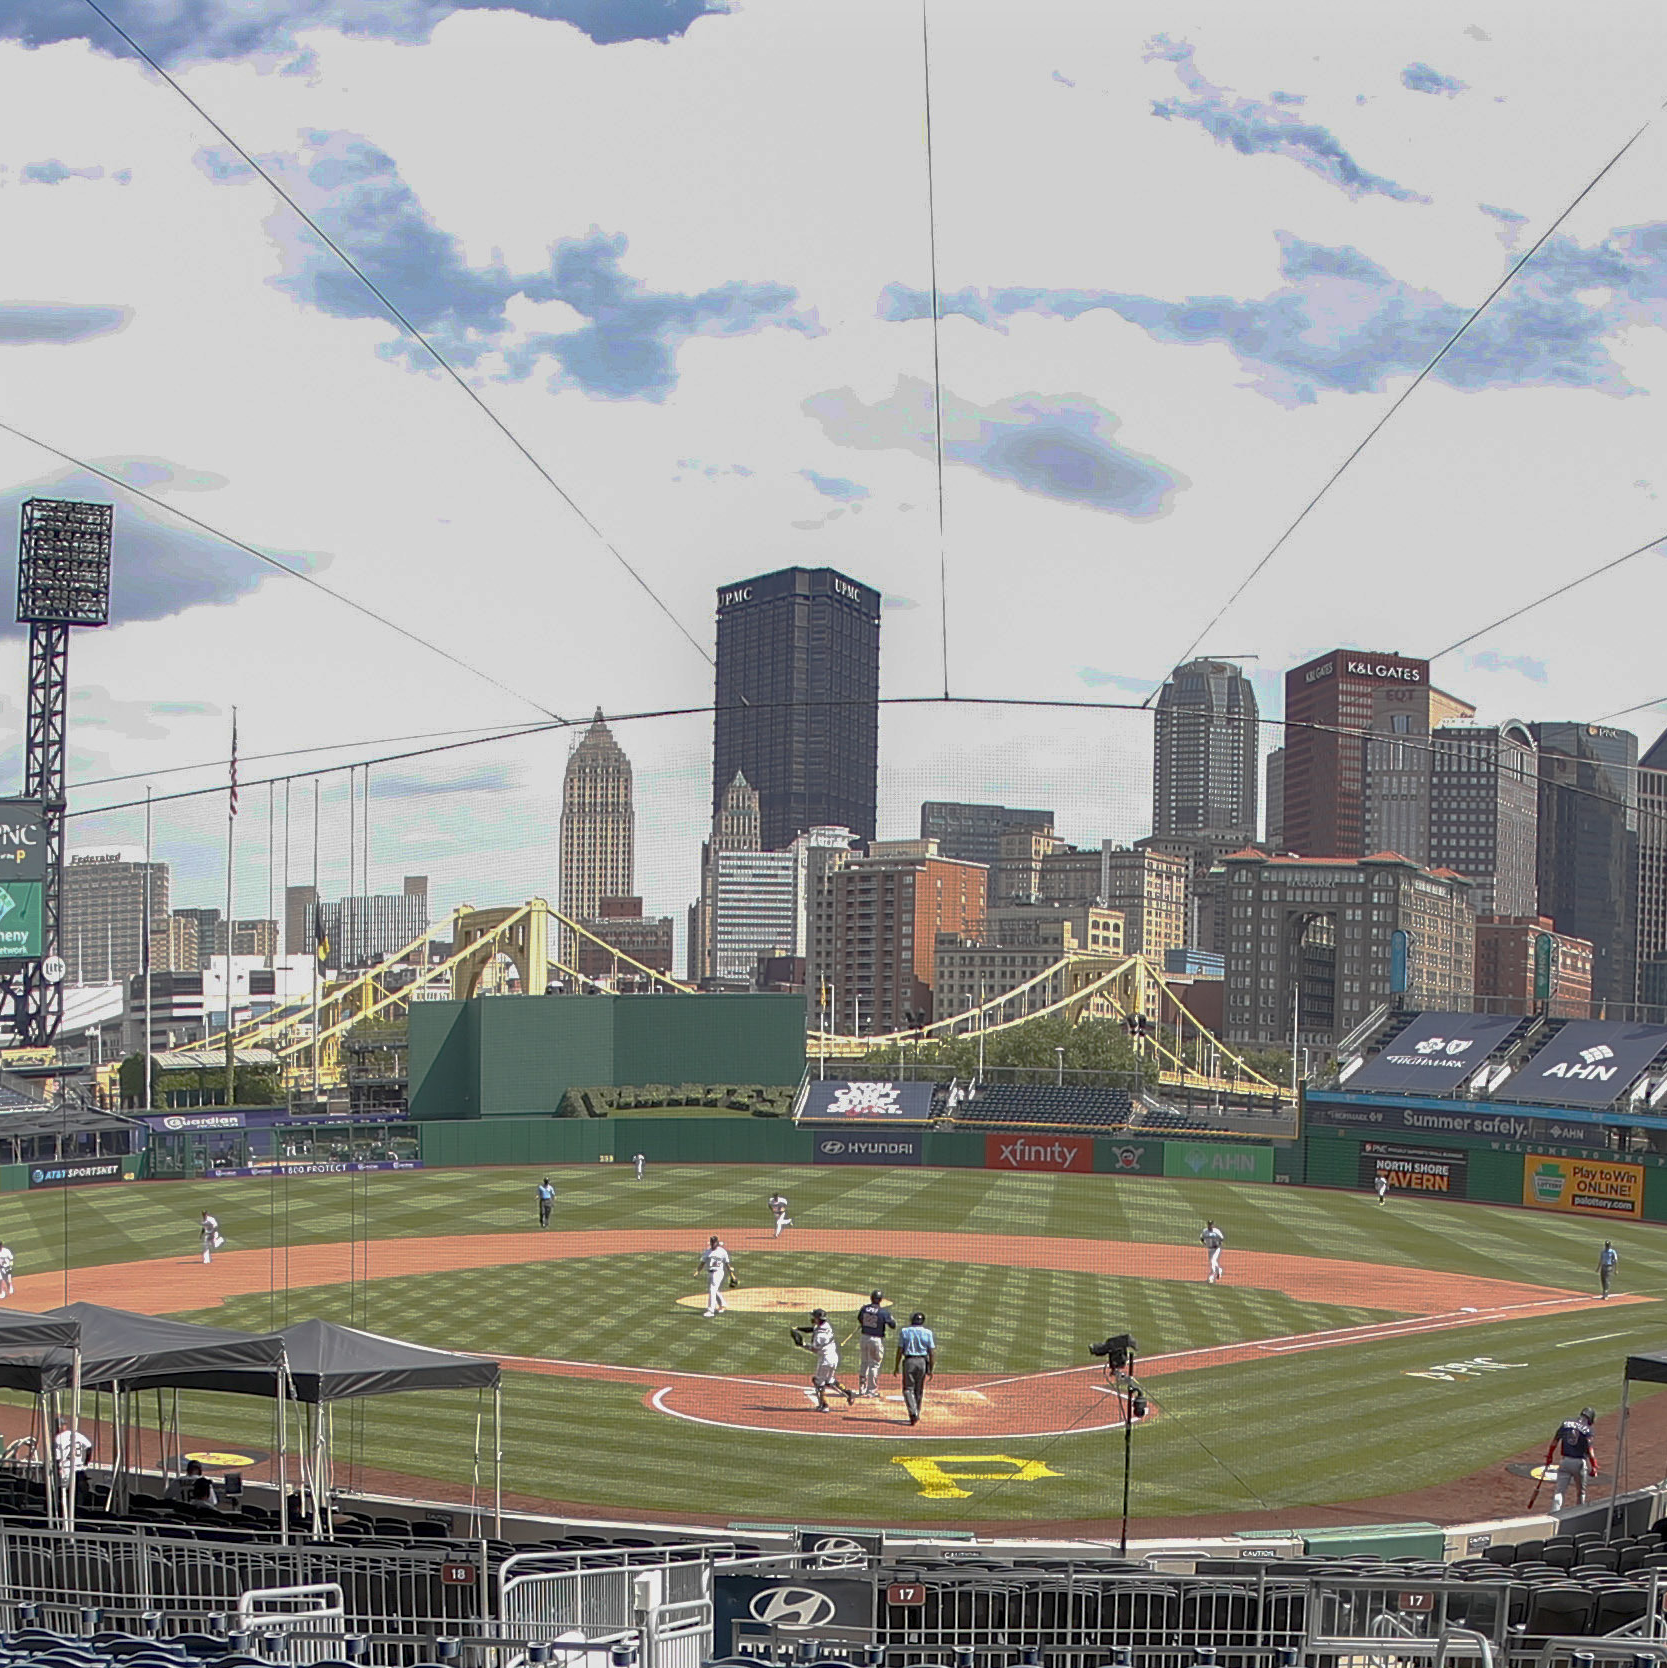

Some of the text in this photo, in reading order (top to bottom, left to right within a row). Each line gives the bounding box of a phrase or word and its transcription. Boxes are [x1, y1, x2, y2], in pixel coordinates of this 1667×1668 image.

[717, 586, 753, 608] UPMC
[835, 578, 861, 603] UPMC
[1348, 661, 1420, 681] K&L GATES
[71, 852, 121, 864] Federated
[1541, 1062, 1619, 1081] AHN
[1403, 1110, 1471, 1130] Summer
[1474, 1116, 1529, 1139] safely.
[1563, 1127, 1584, 1139] AHN
[848, 1143, 913, 1155] HYUNDAI
[998, 1138, 1078, 1169] xfinity
[1491, 1142, 1569, 1157] WELCOME
[307, 1163, 347, 1174] PROTECT
[1211, 1152, 1256, 1173] AHN
[1376, 1159, 1450, 1176] NORTH SHORE
[68, 1165, 119, 1178] SPORTSNET
[1572, 1165, 1638, 1184] Play to Win
[1576, 1180, 1632, 1196] ONLINE!
[1573, 1196, 1634, 1211] palottery.com
[451, 1568, 466, 1580] 18
[898, 1589, 914, 1600] 17
[1409, 1596, 1424, 1606] 17
